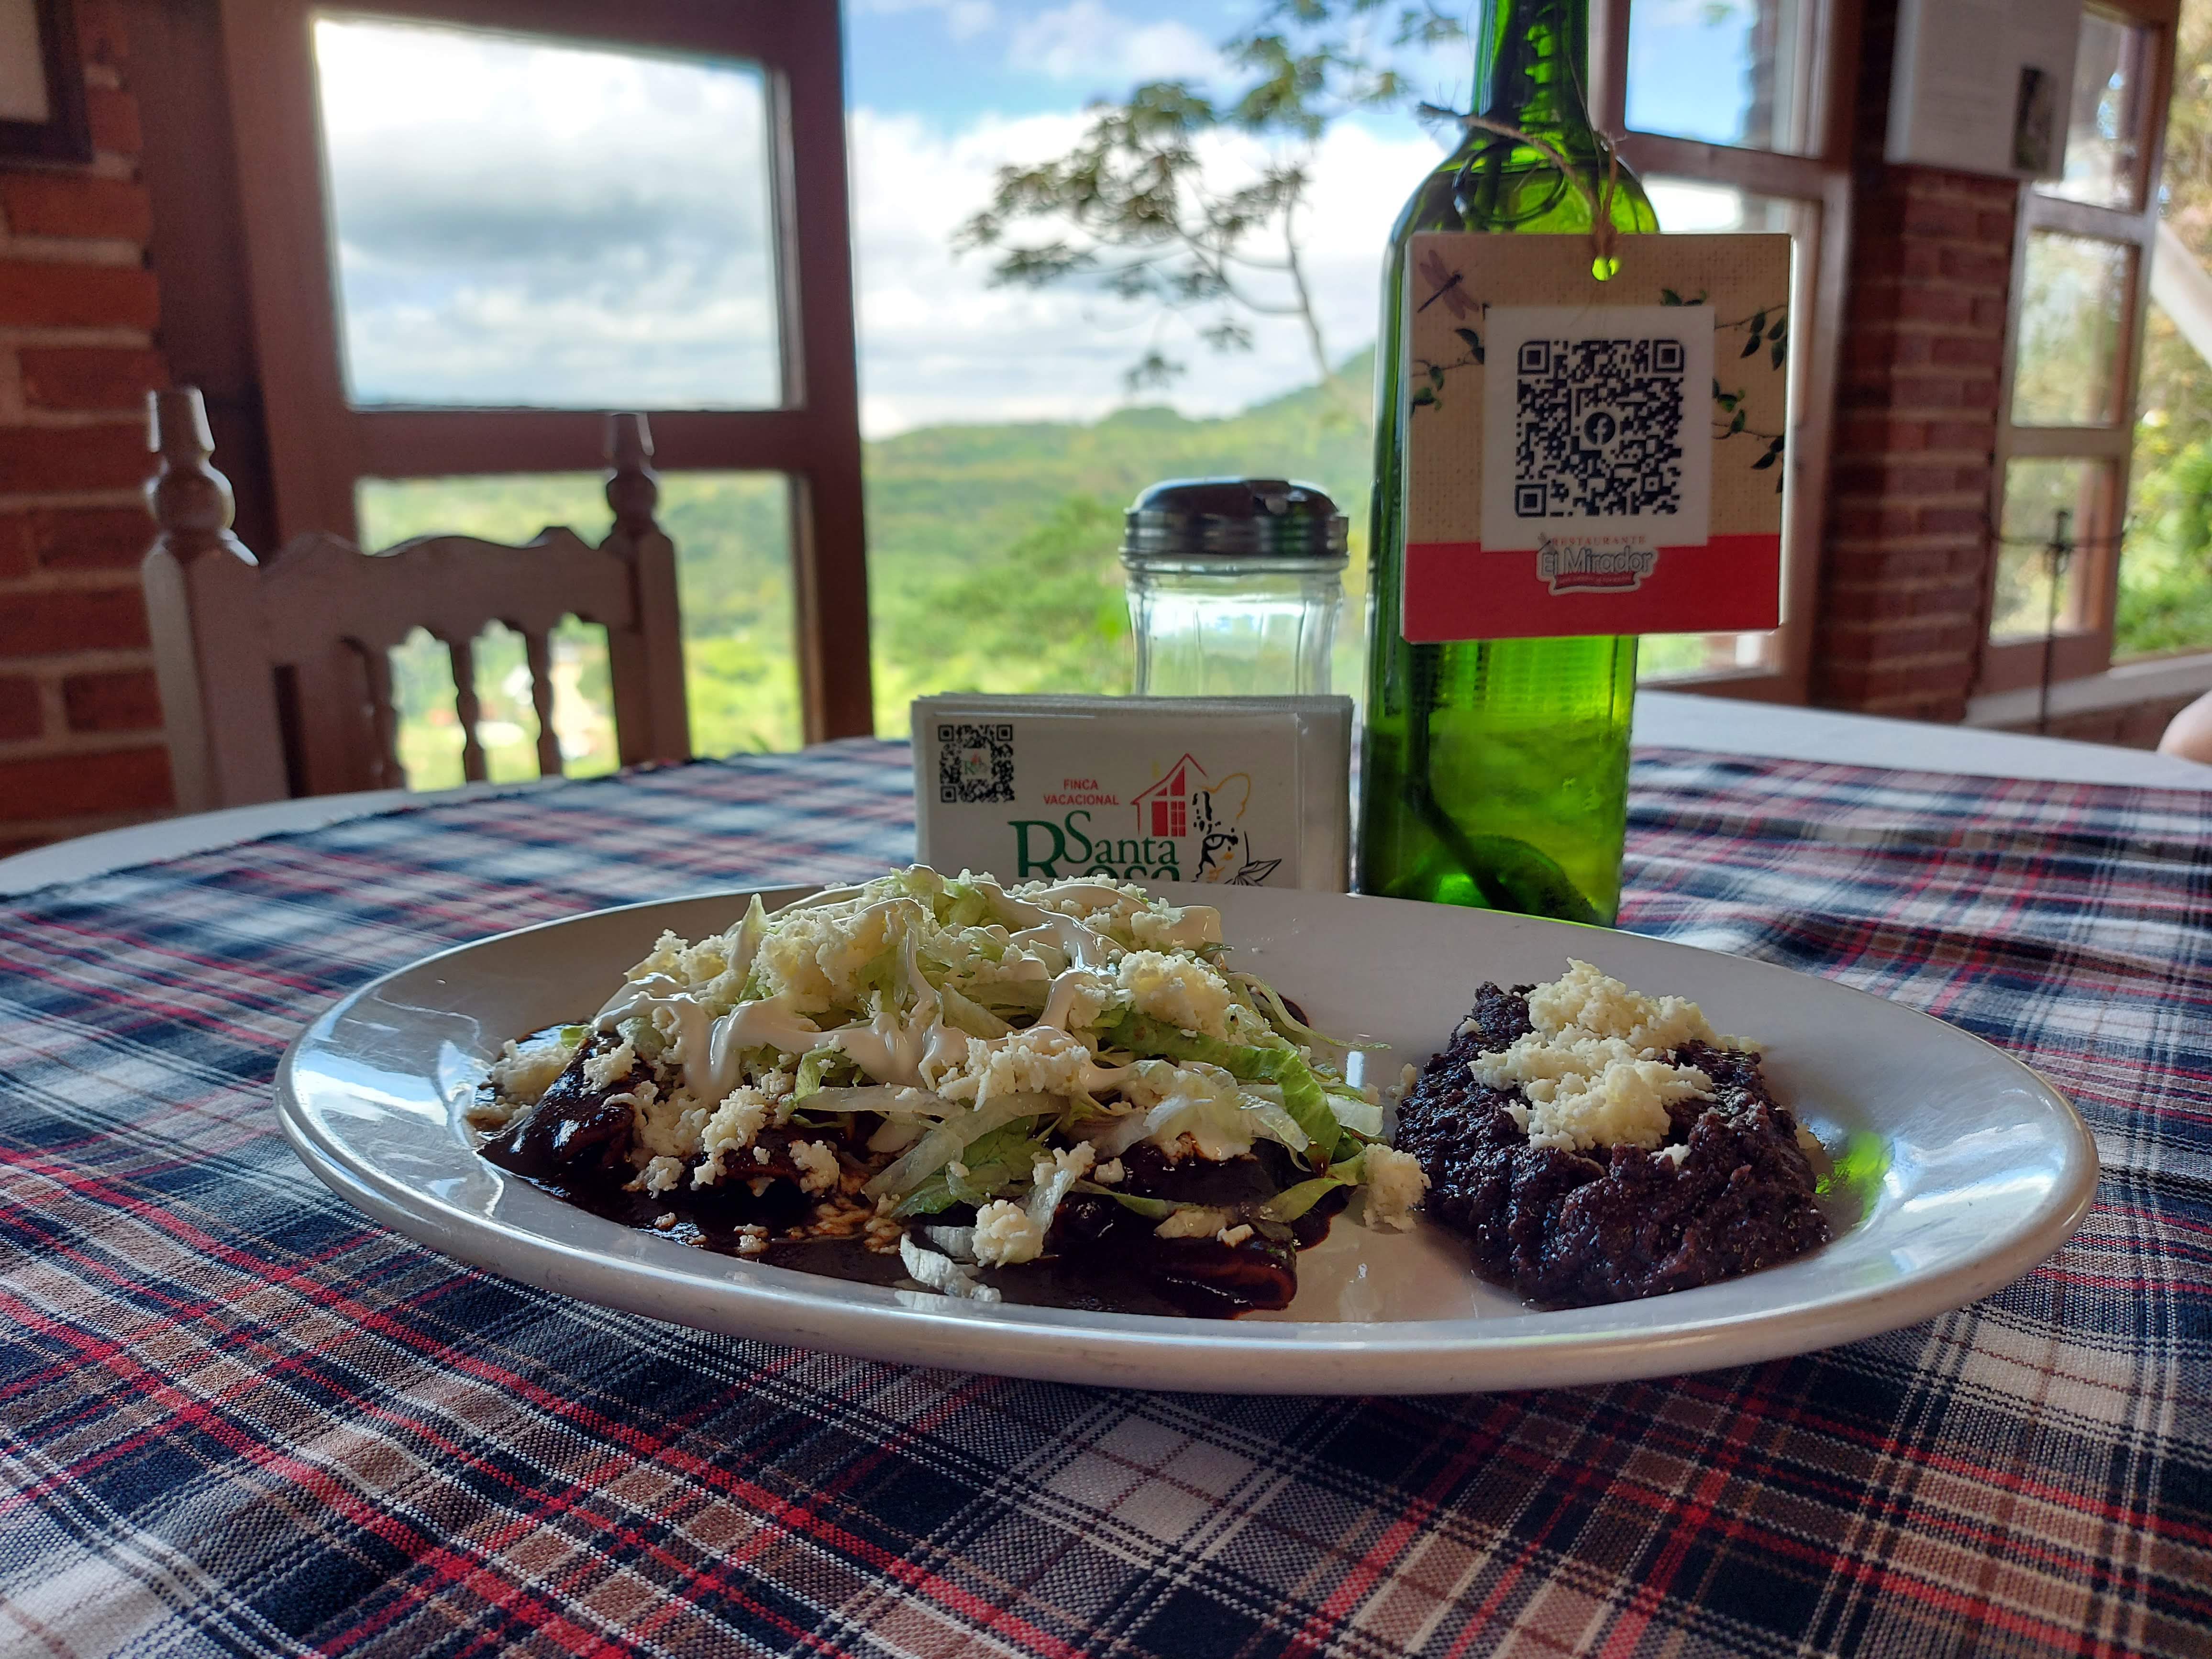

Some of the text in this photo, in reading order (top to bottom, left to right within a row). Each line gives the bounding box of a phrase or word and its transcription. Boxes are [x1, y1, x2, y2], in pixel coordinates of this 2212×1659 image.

[1541, 545, 1653, 575] El Mirador
[1063, 778, 1099, 790] FINCA
[1043, 794, 1120, 805] VACACIONAL
[1063, 810, 1180, 865] Santa
